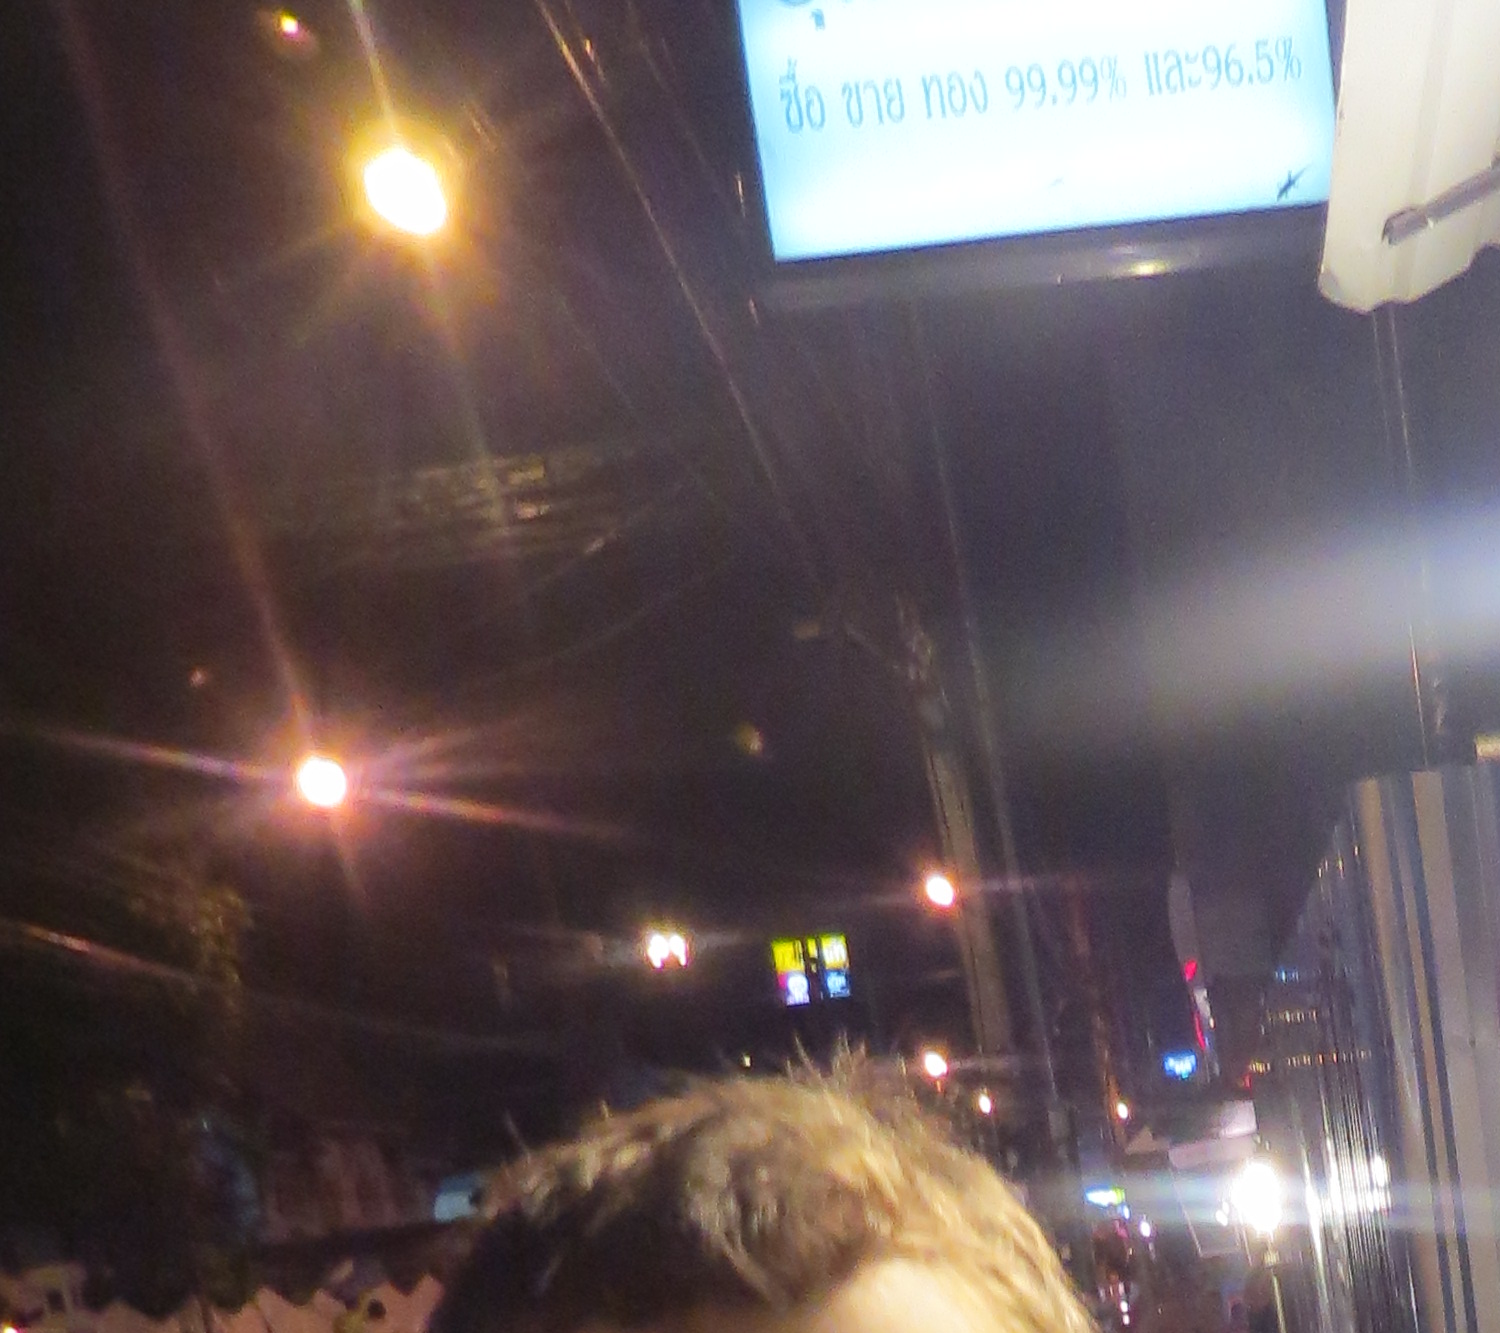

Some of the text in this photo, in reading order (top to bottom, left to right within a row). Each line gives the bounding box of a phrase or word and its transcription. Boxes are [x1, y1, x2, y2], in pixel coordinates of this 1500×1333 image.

[842, 78, 906, 128] ขาย
[921, 70, 989, 120] ทอง
[1004, 53, 1127, 110] 99.99%
